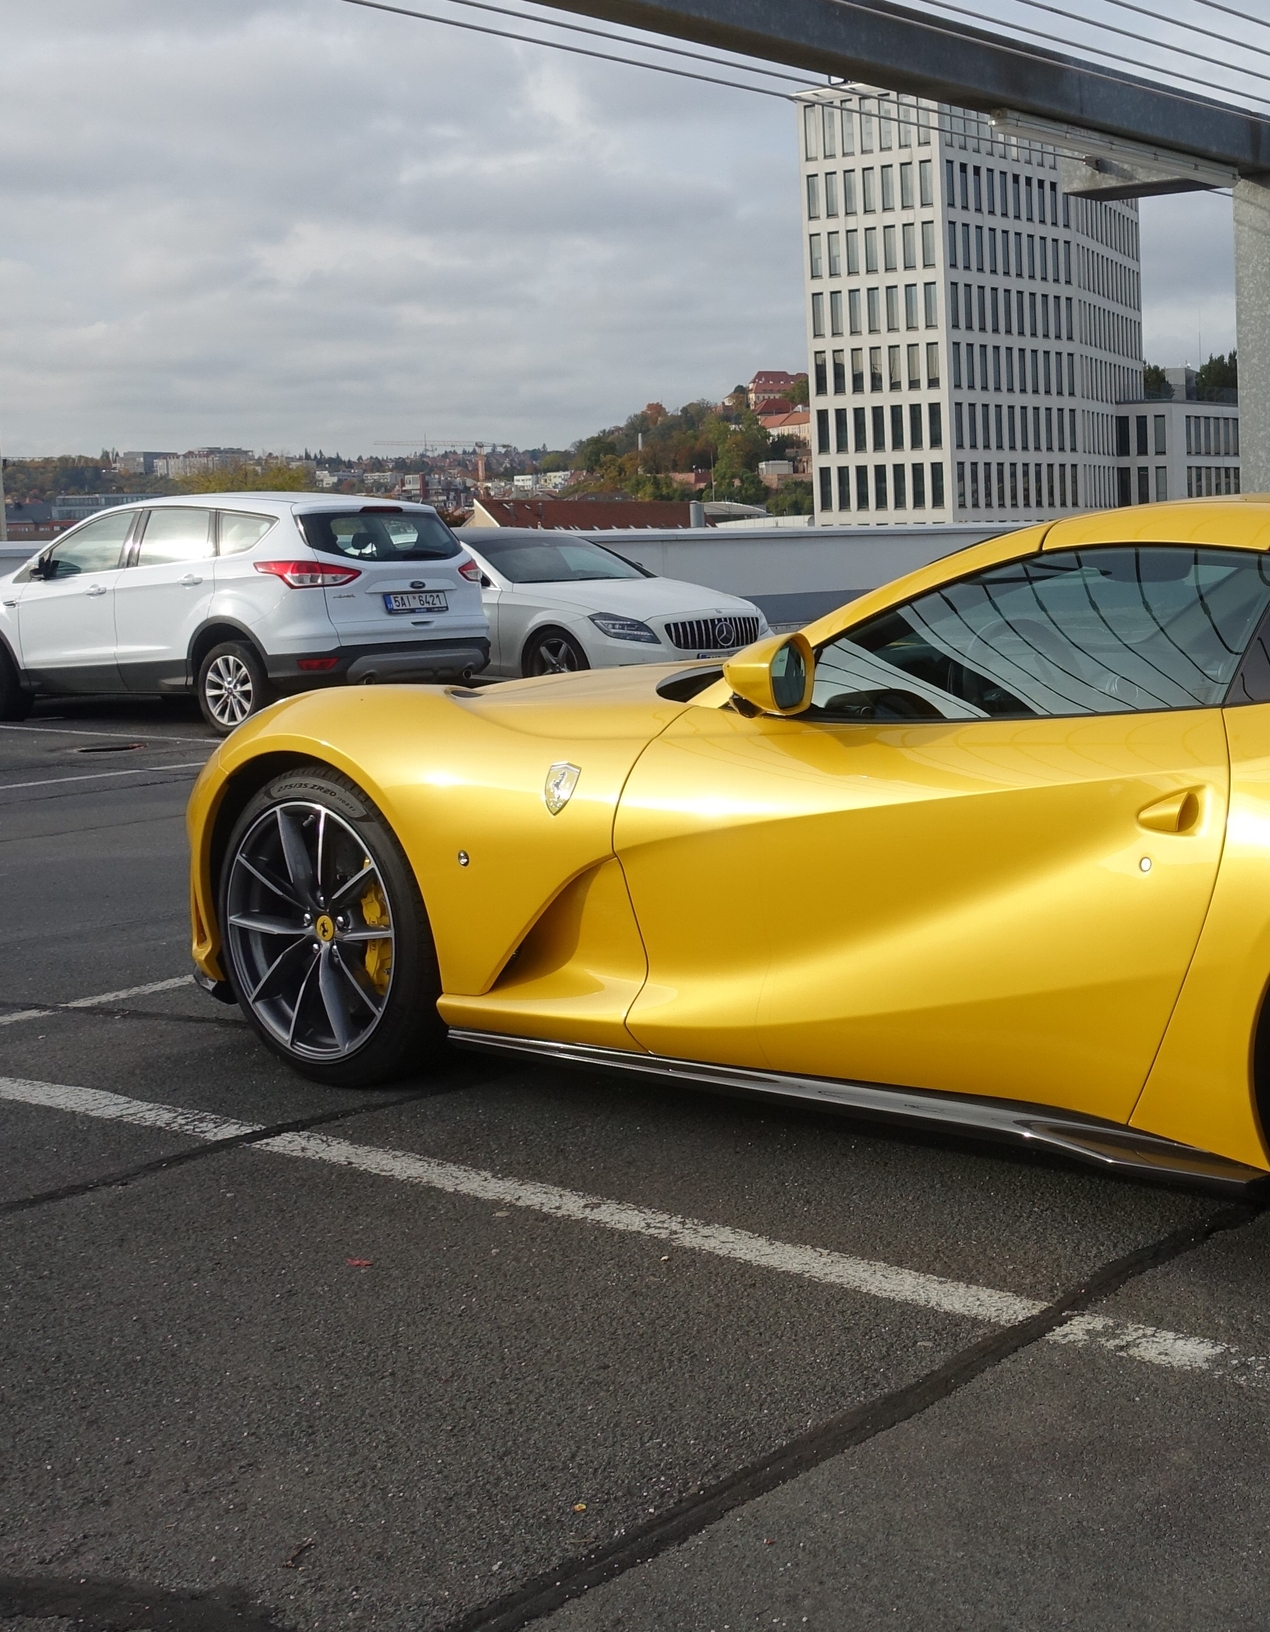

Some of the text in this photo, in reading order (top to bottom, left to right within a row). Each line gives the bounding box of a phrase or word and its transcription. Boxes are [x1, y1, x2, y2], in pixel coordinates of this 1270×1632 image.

[419, 594, 443, 606] 6421
[277, 782, 309, 792] 275/35
[309, 783, 337, 797] ZR20
